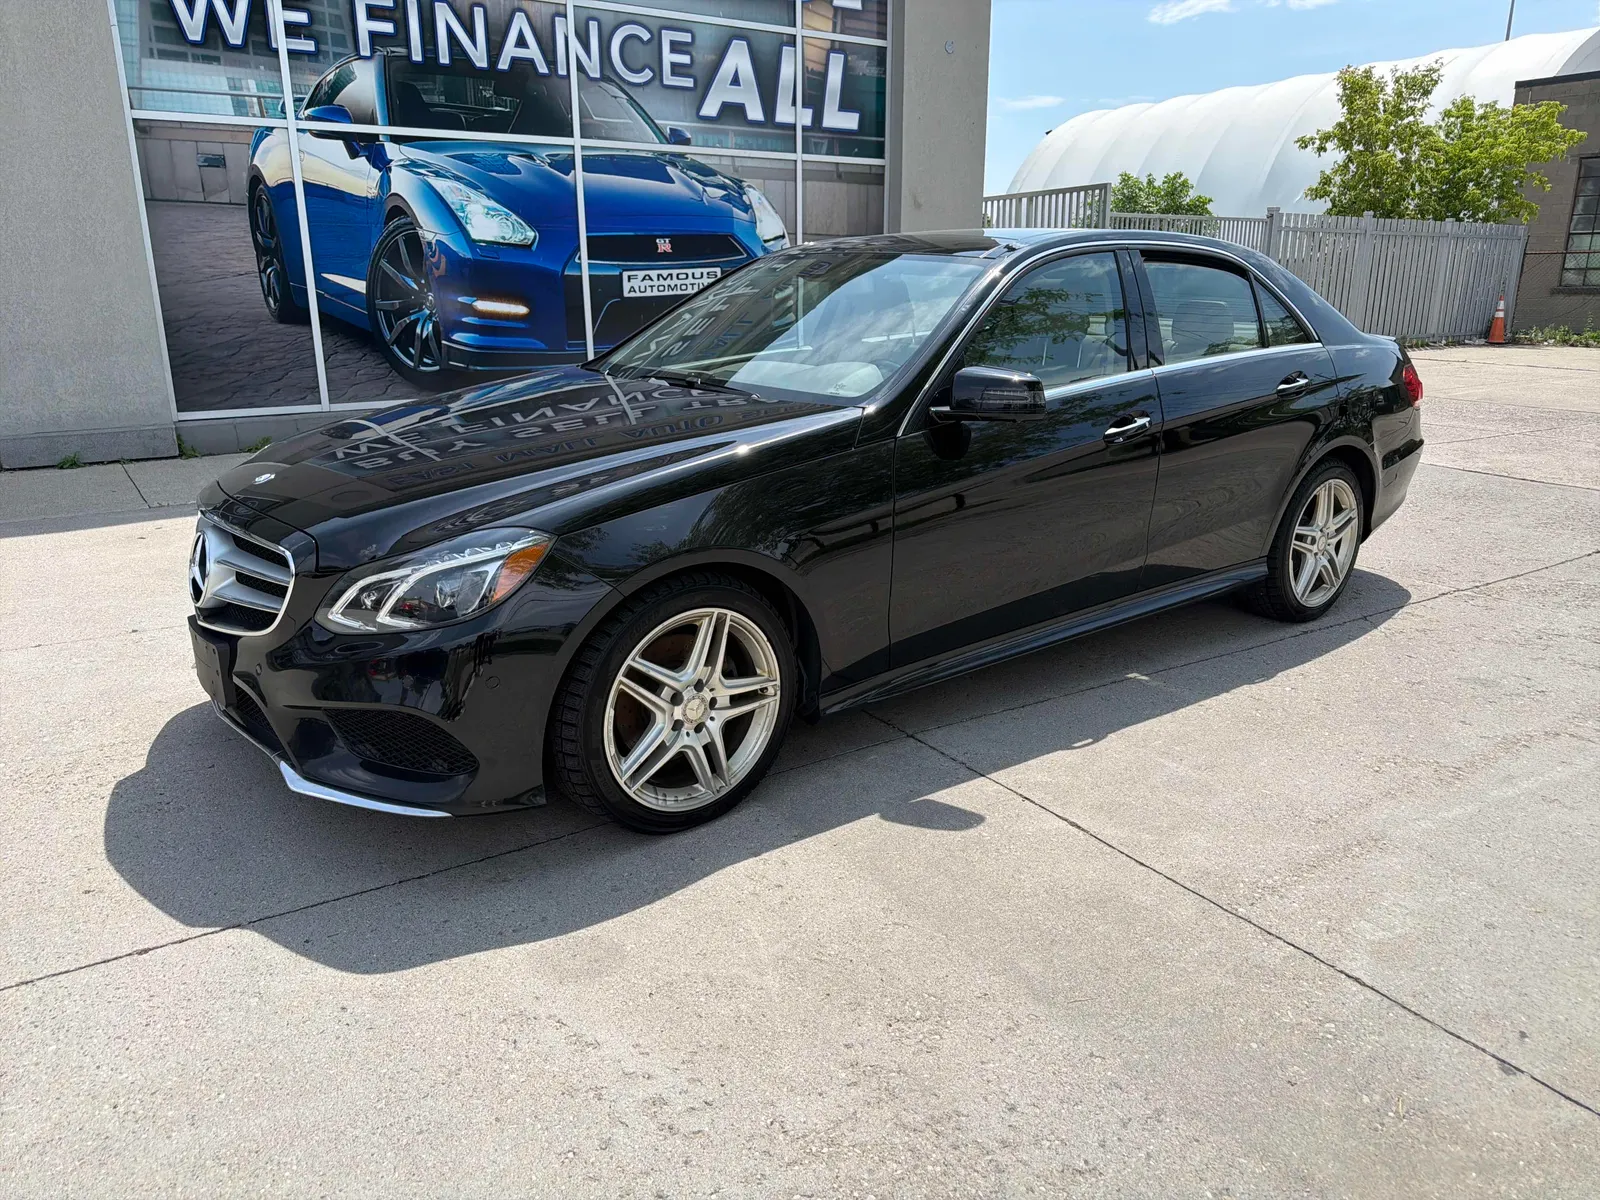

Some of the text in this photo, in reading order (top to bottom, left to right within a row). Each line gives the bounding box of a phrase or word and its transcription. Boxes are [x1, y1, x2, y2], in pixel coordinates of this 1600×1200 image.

[170, 0, 860, 131] WE FINANCE ALL
[627, 270, 718, 283] FAMOUS
